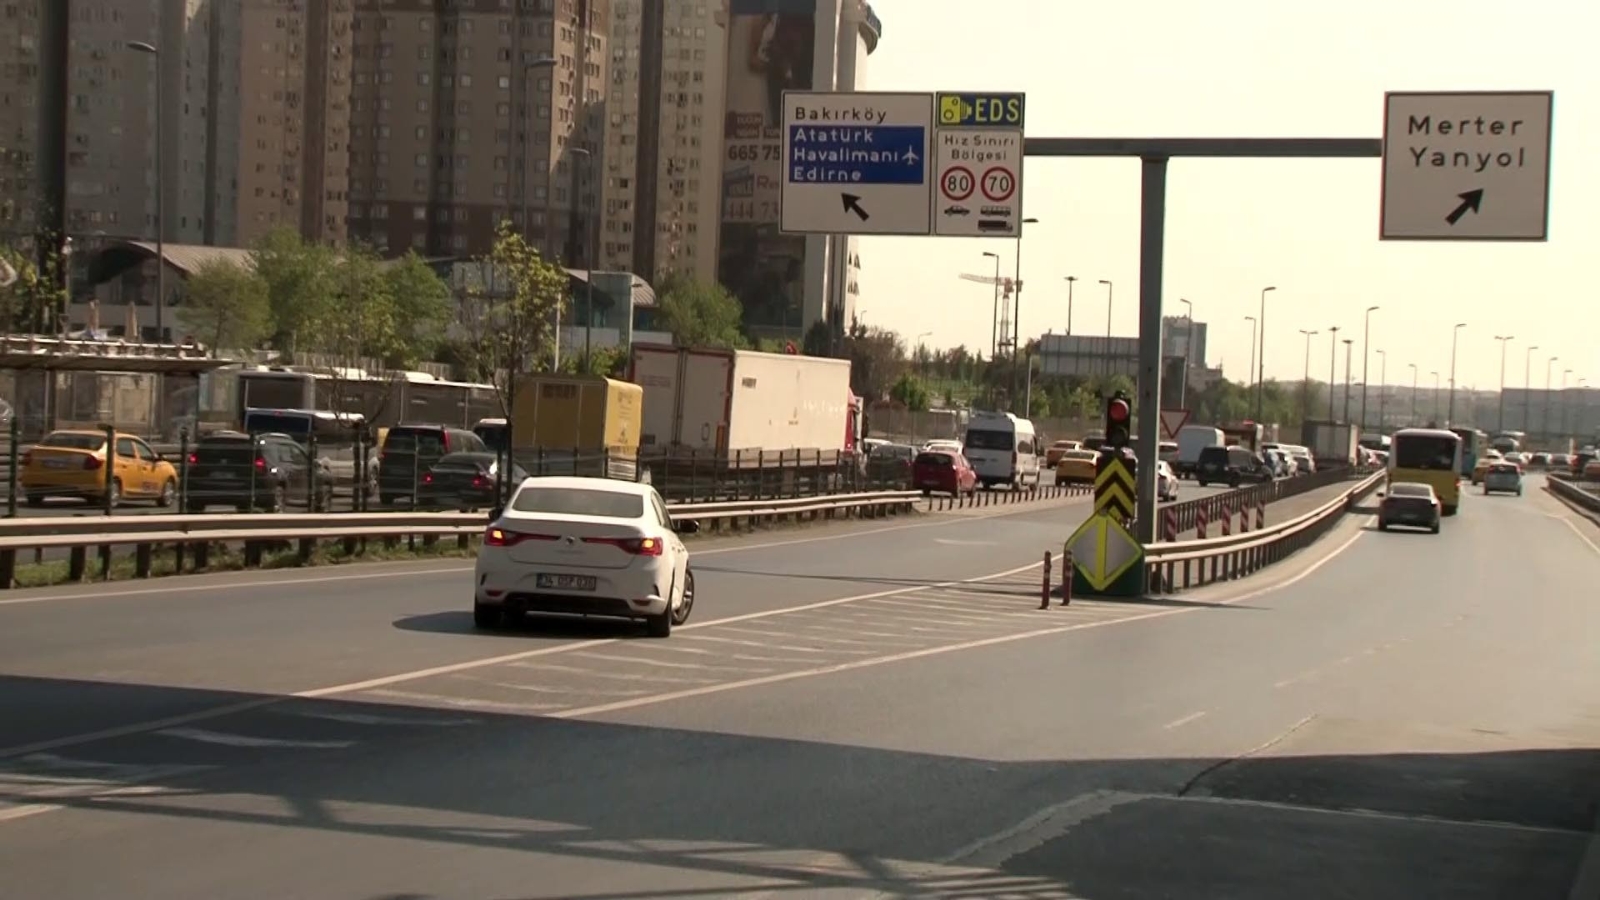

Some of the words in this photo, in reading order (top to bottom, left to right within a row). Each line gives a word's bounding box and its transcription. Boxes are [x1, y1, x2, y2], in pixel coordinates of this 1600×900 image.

[795, 106, 887, 125] Bakırköy
[975, 98, 1019, 122] EDS
[1408, 115, 1524, 136] Merter
[794, 127, 874, 143] Atatürk
[944, 135, 969, 147] Hız
[728, 144, 759, 162] 665
[951, 148, 1007, 163] Bölgesi
[1409, 146, 1525, 173] Yanyol
[794, 166, 862, 181] Edirne
[947, 174, 969, 192] 80
[988, 175, 1010, 193] 70
